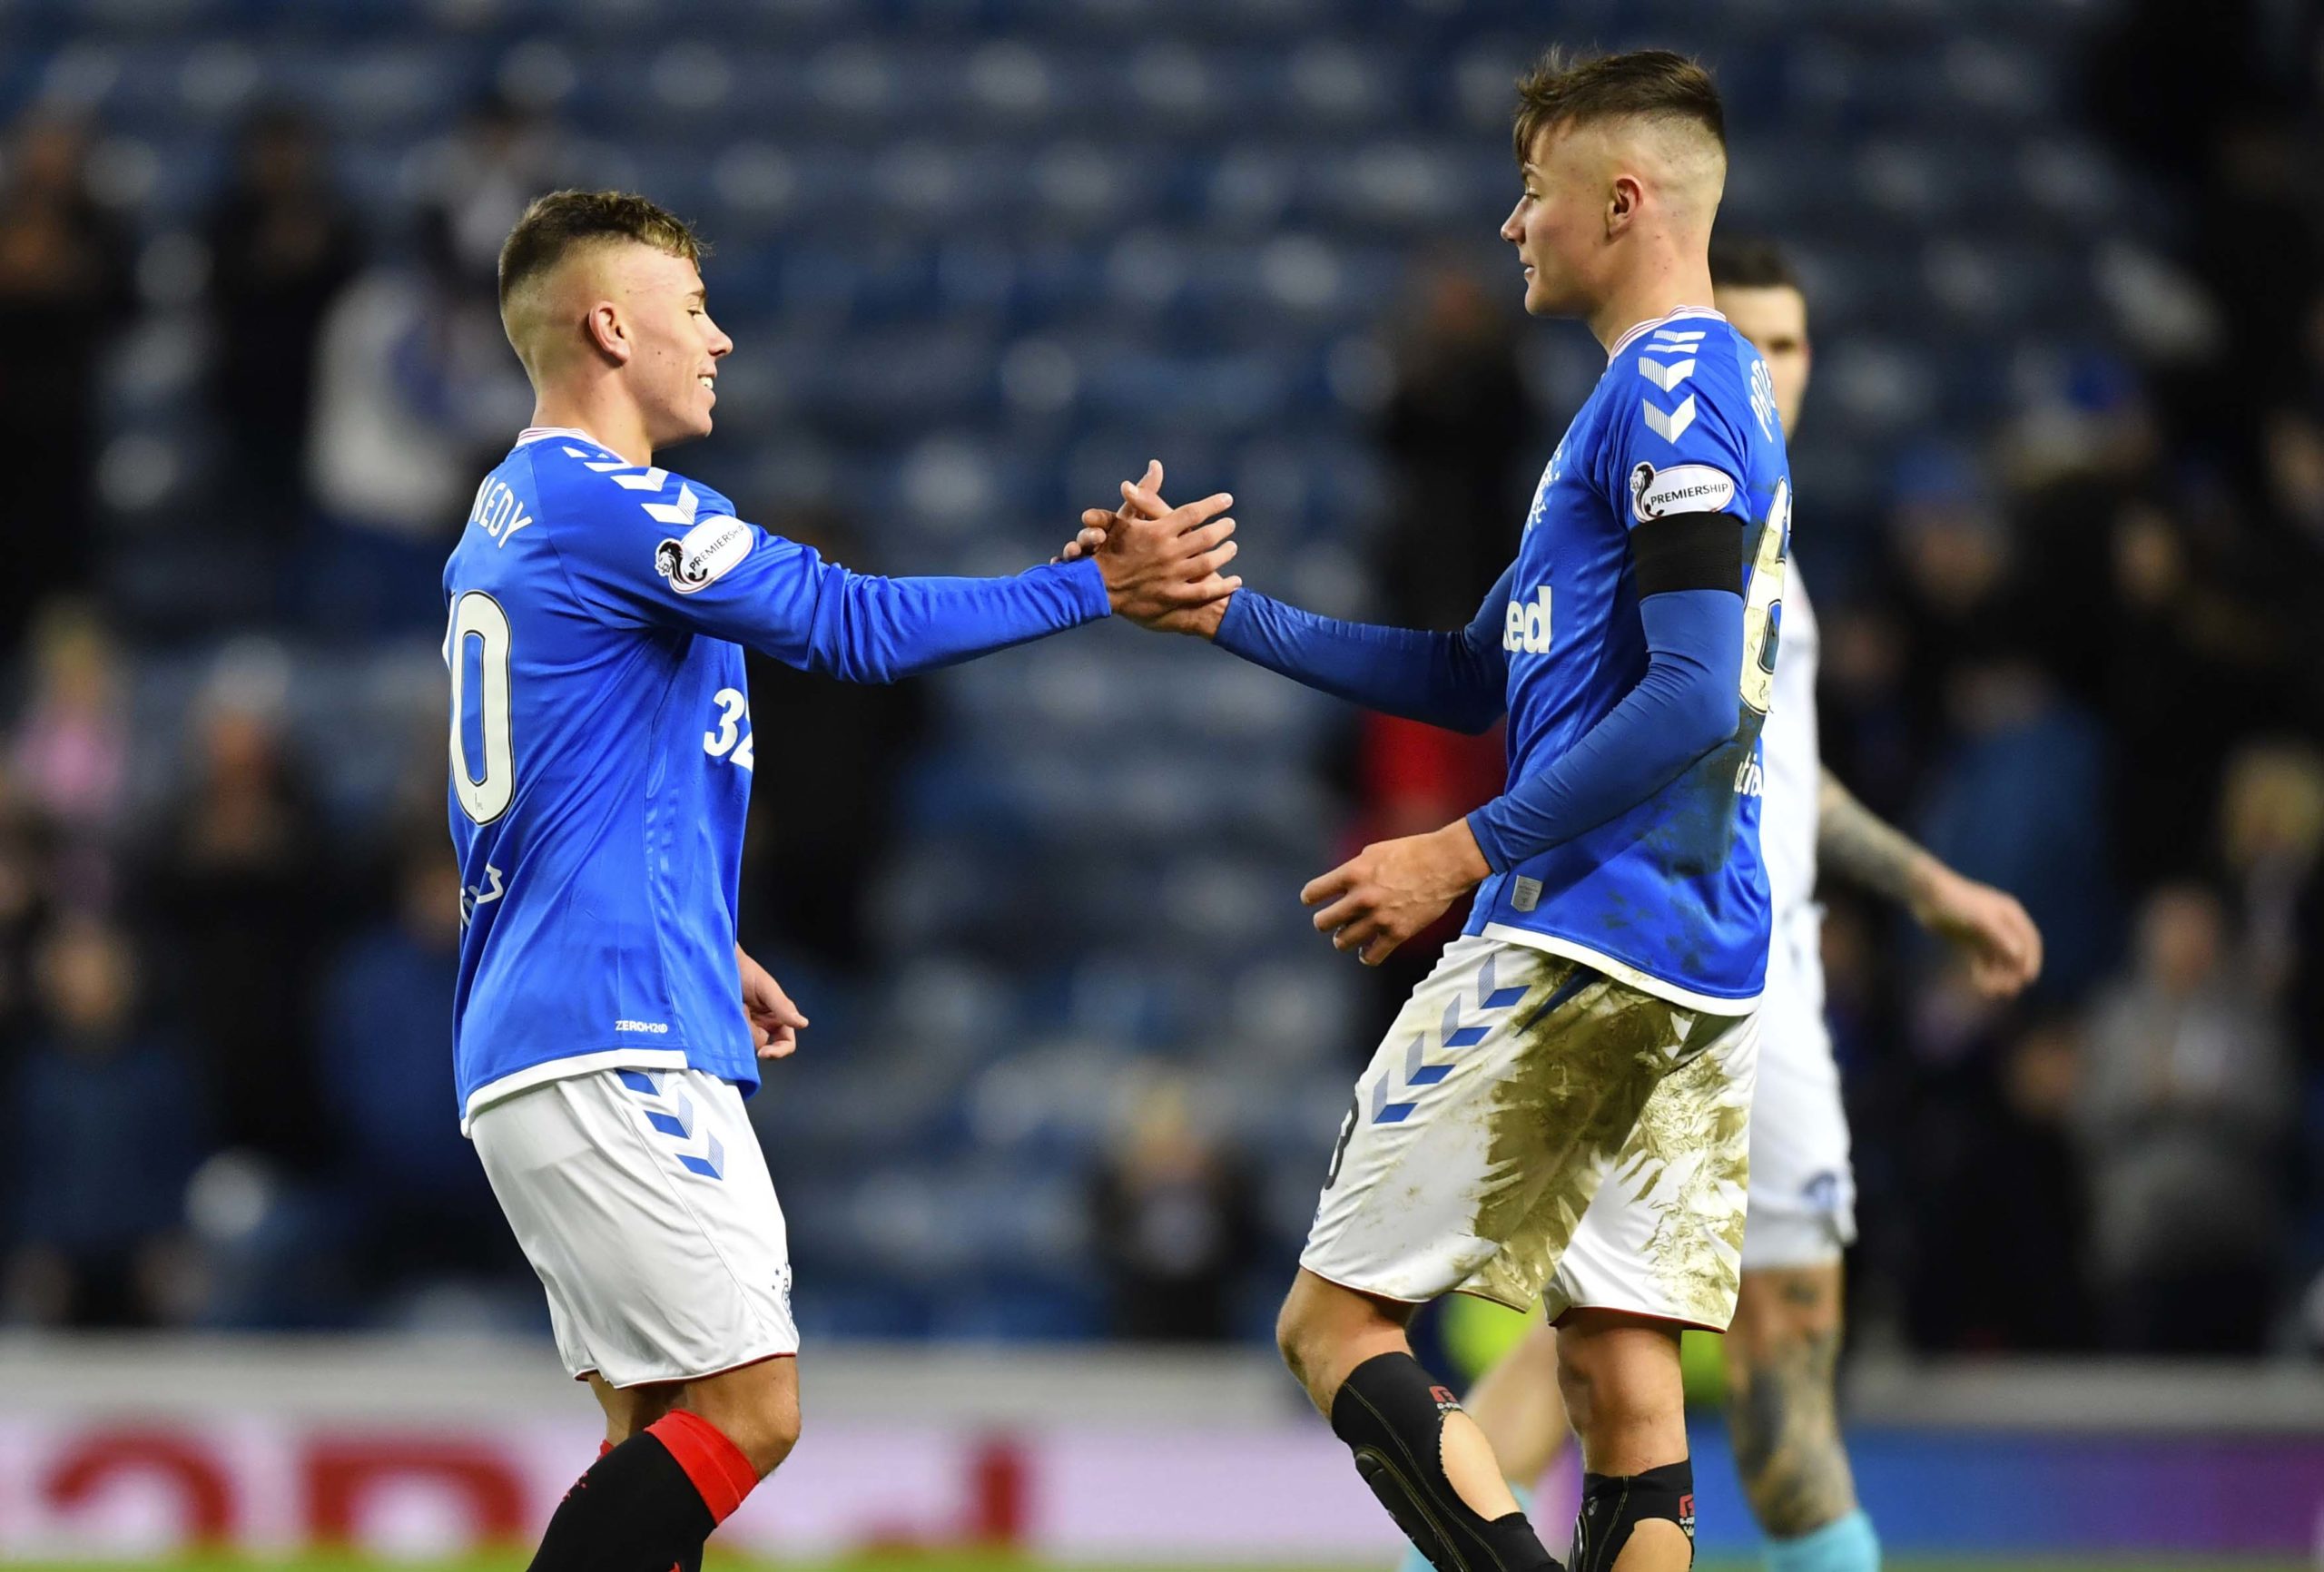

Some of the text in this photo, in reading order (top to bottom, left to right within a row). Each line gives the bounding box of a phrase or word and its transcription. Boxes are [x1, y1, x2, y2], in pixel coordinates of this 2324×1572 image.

[1650, 483, 1728, 506] PREMIERSHIP
[1502, 585, 1552, 653] ed
[443, 590, 514, 827] 0
